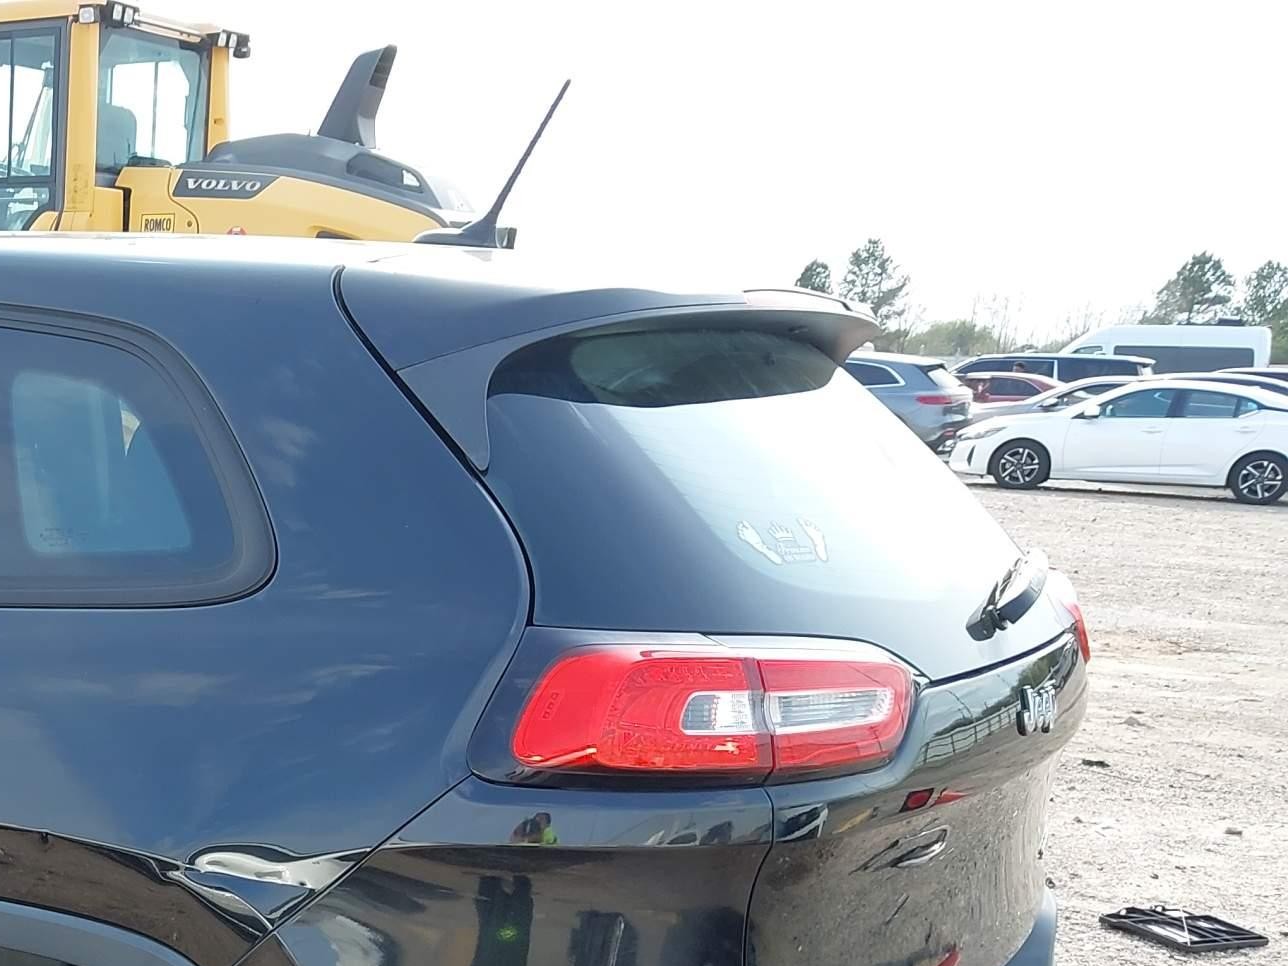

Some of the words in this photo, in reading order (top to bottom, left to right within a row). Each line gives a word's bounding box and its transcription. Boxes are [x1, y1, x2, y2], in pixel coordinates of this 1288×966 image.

[185, 178, 262, 192] VOLVO
[144, 218, 172, 232] ROMCO
[1016, 680, 1056, 735] Jeep
